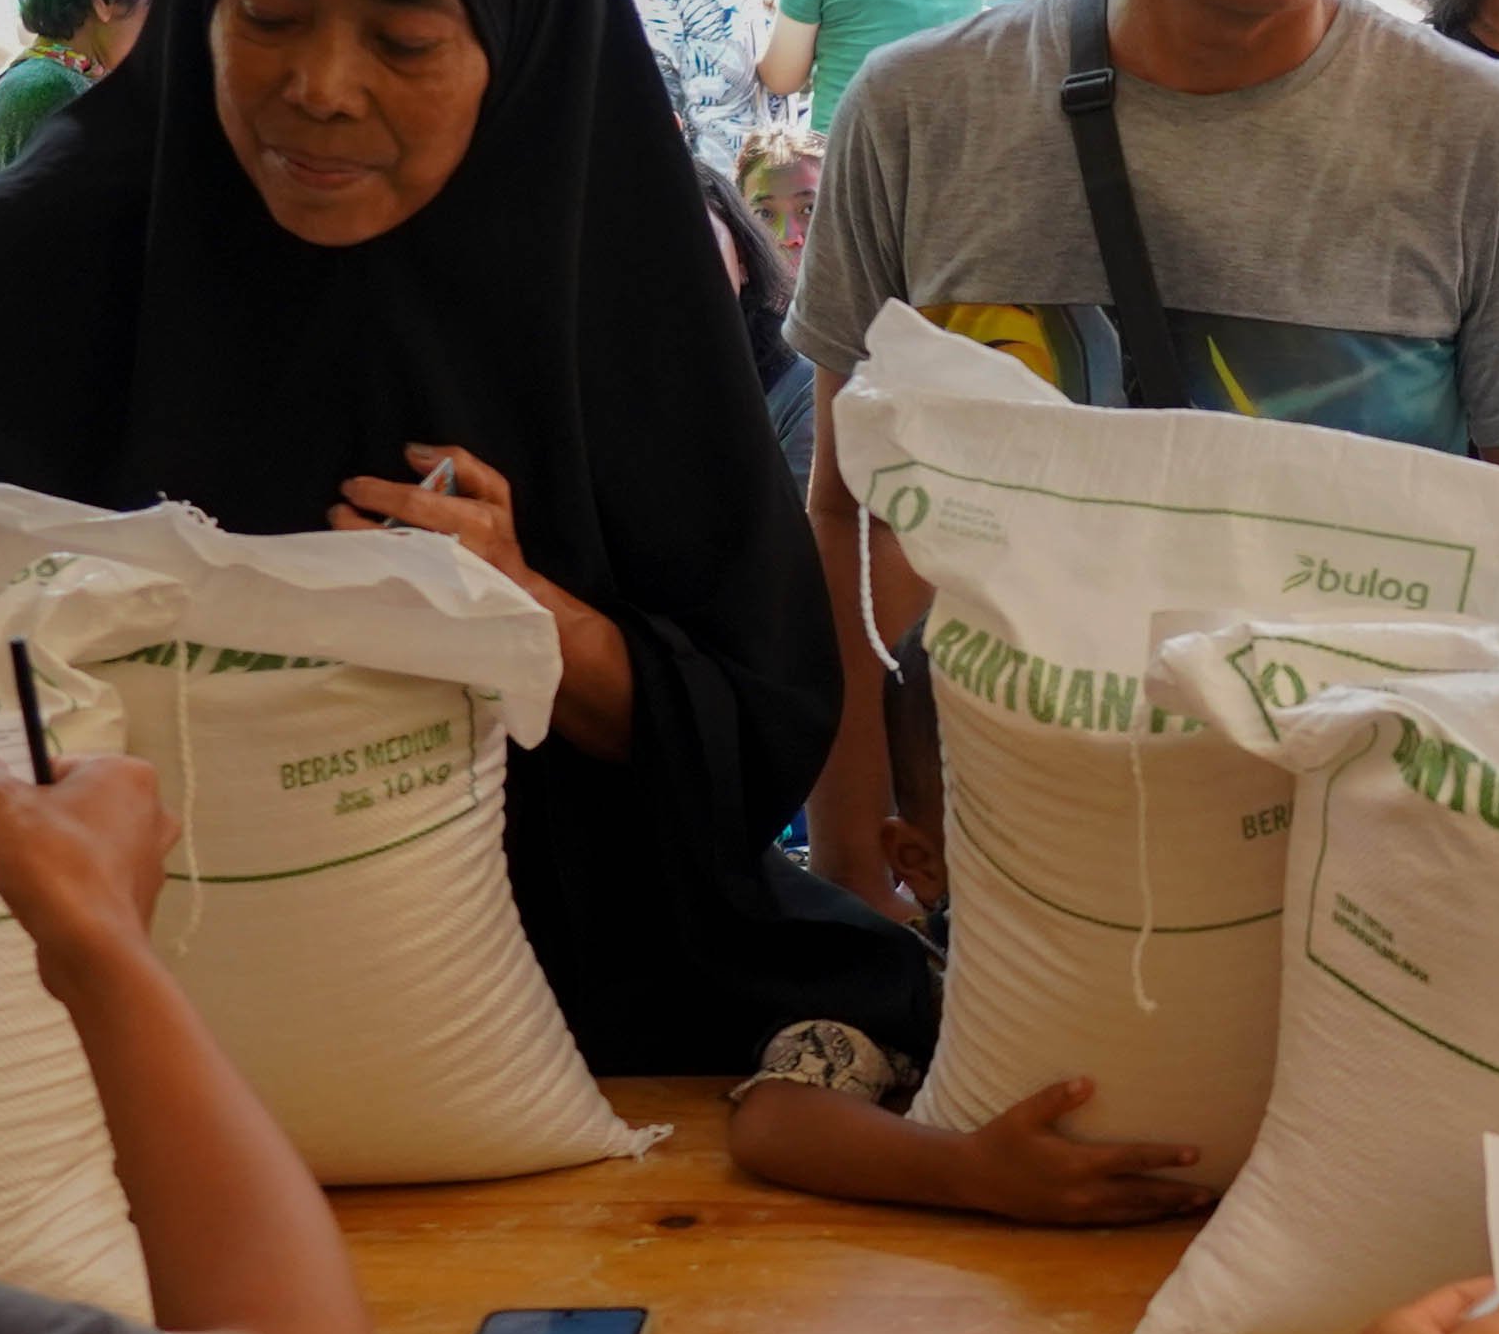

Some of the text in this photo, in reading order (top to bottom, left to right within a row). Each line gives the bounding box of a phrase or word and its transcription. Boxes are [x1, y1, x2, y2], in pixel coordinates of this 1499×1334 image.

[1317, 559, 1430, 611] bulog
[930, 617, 1139, 734] BANTUAN
[280, 719, 451, 790] BERAS MEDIUM
[382, 763, 451, 799] 10 kg
